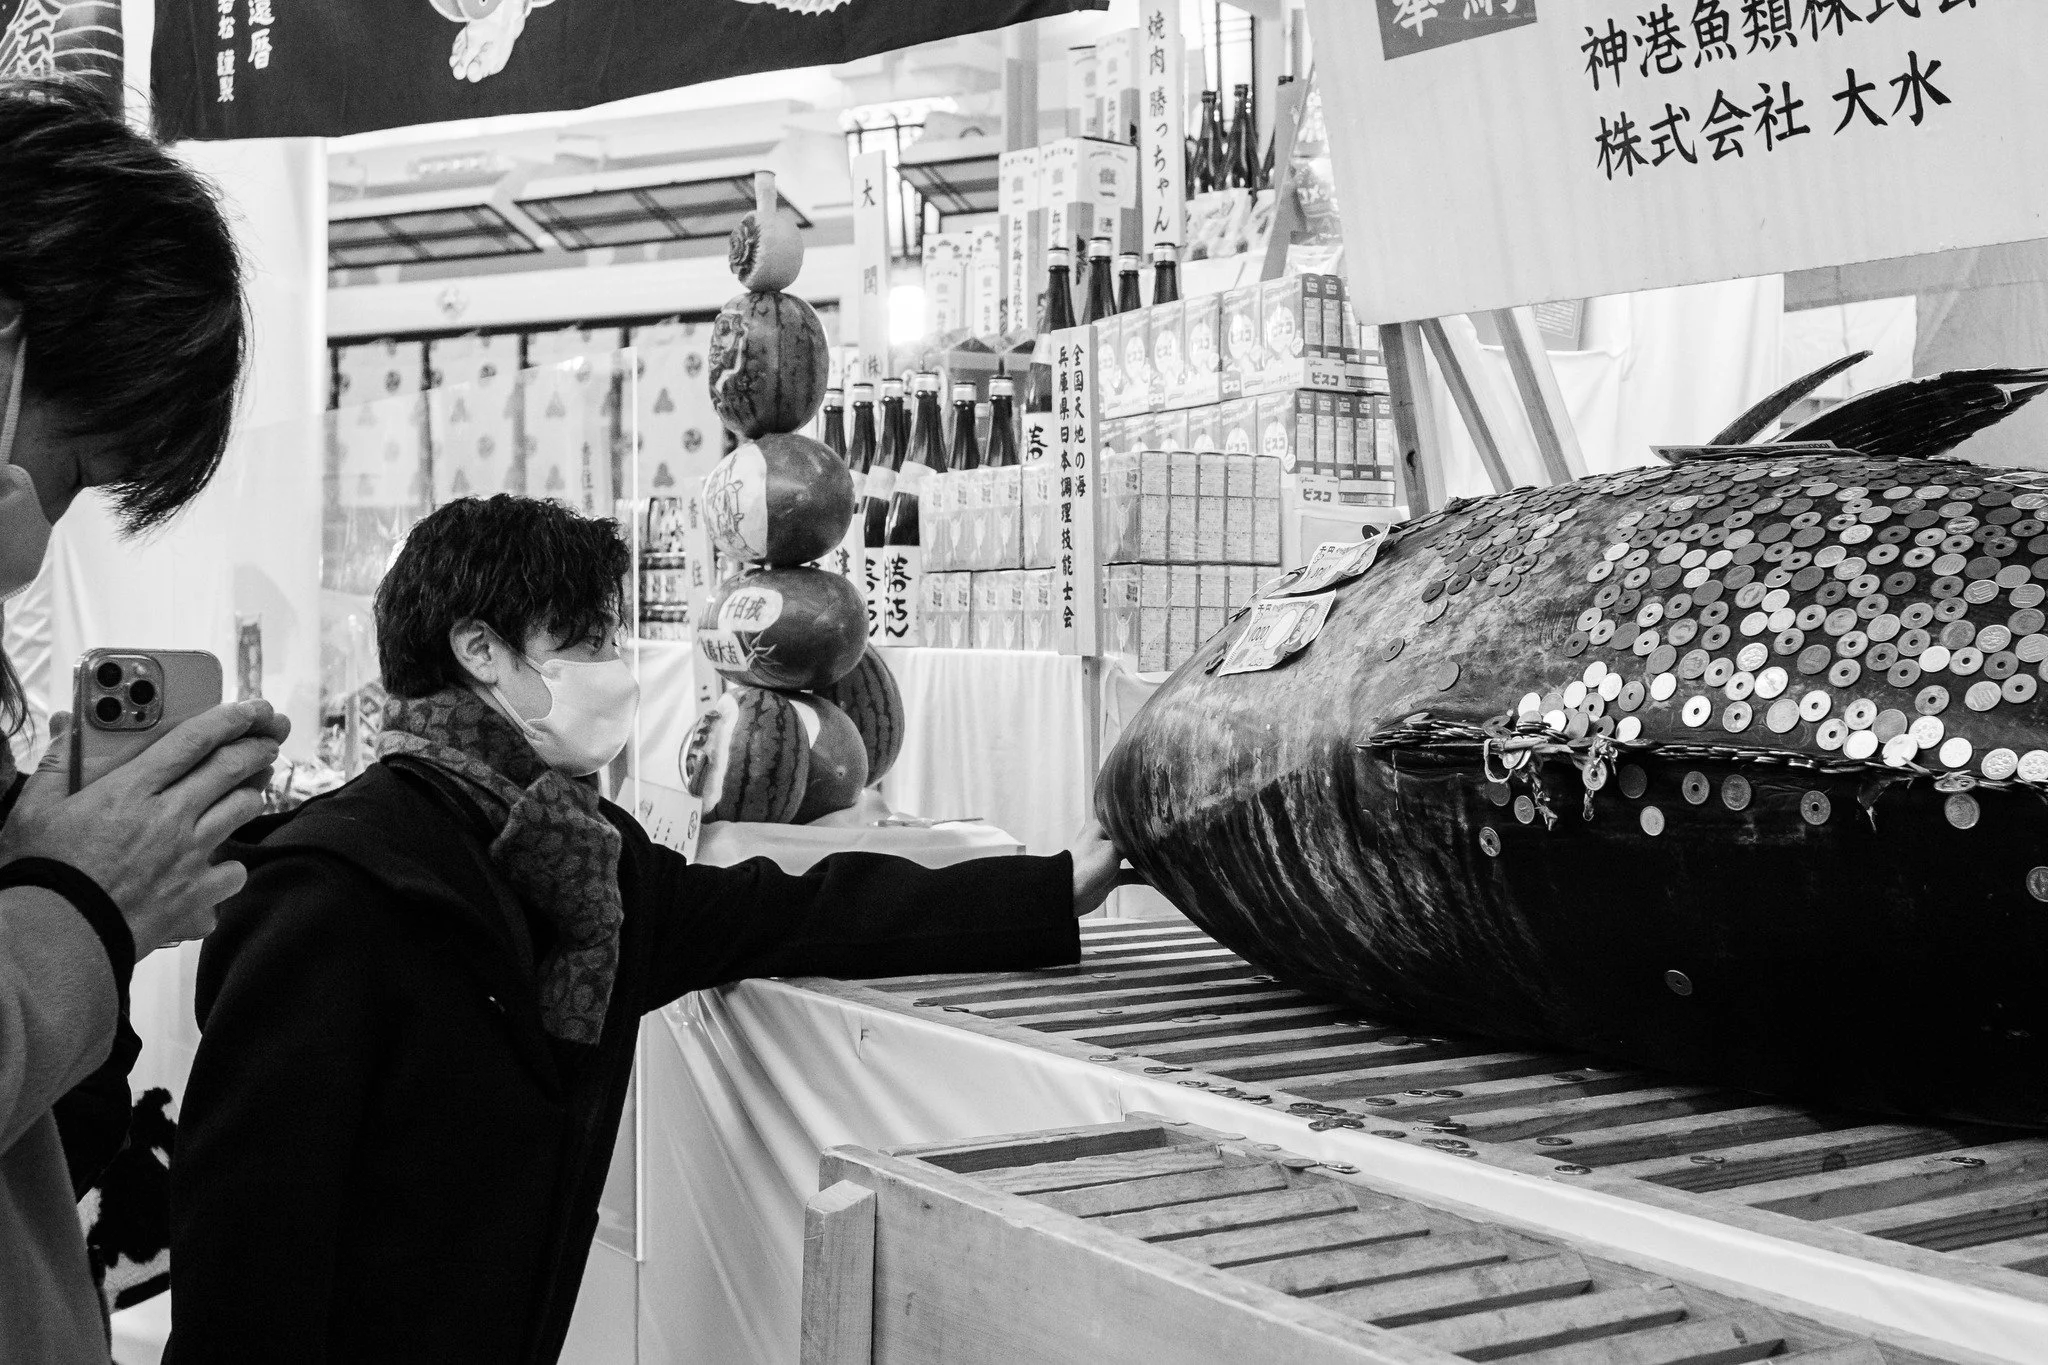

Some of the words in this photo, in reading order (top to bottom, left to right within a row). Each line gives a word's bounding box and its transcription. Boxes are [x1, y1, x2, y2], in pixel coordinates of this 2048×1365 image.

[1580, 0, 1977, 91] 神港魚類株
[1596, 81, 1811, 181] 株式会社
[1831, 50, 1952, 136] 大水
[1311, 371, 1340, 387] ビスコ
[1302, 488, 1332, 503] ビスコ
